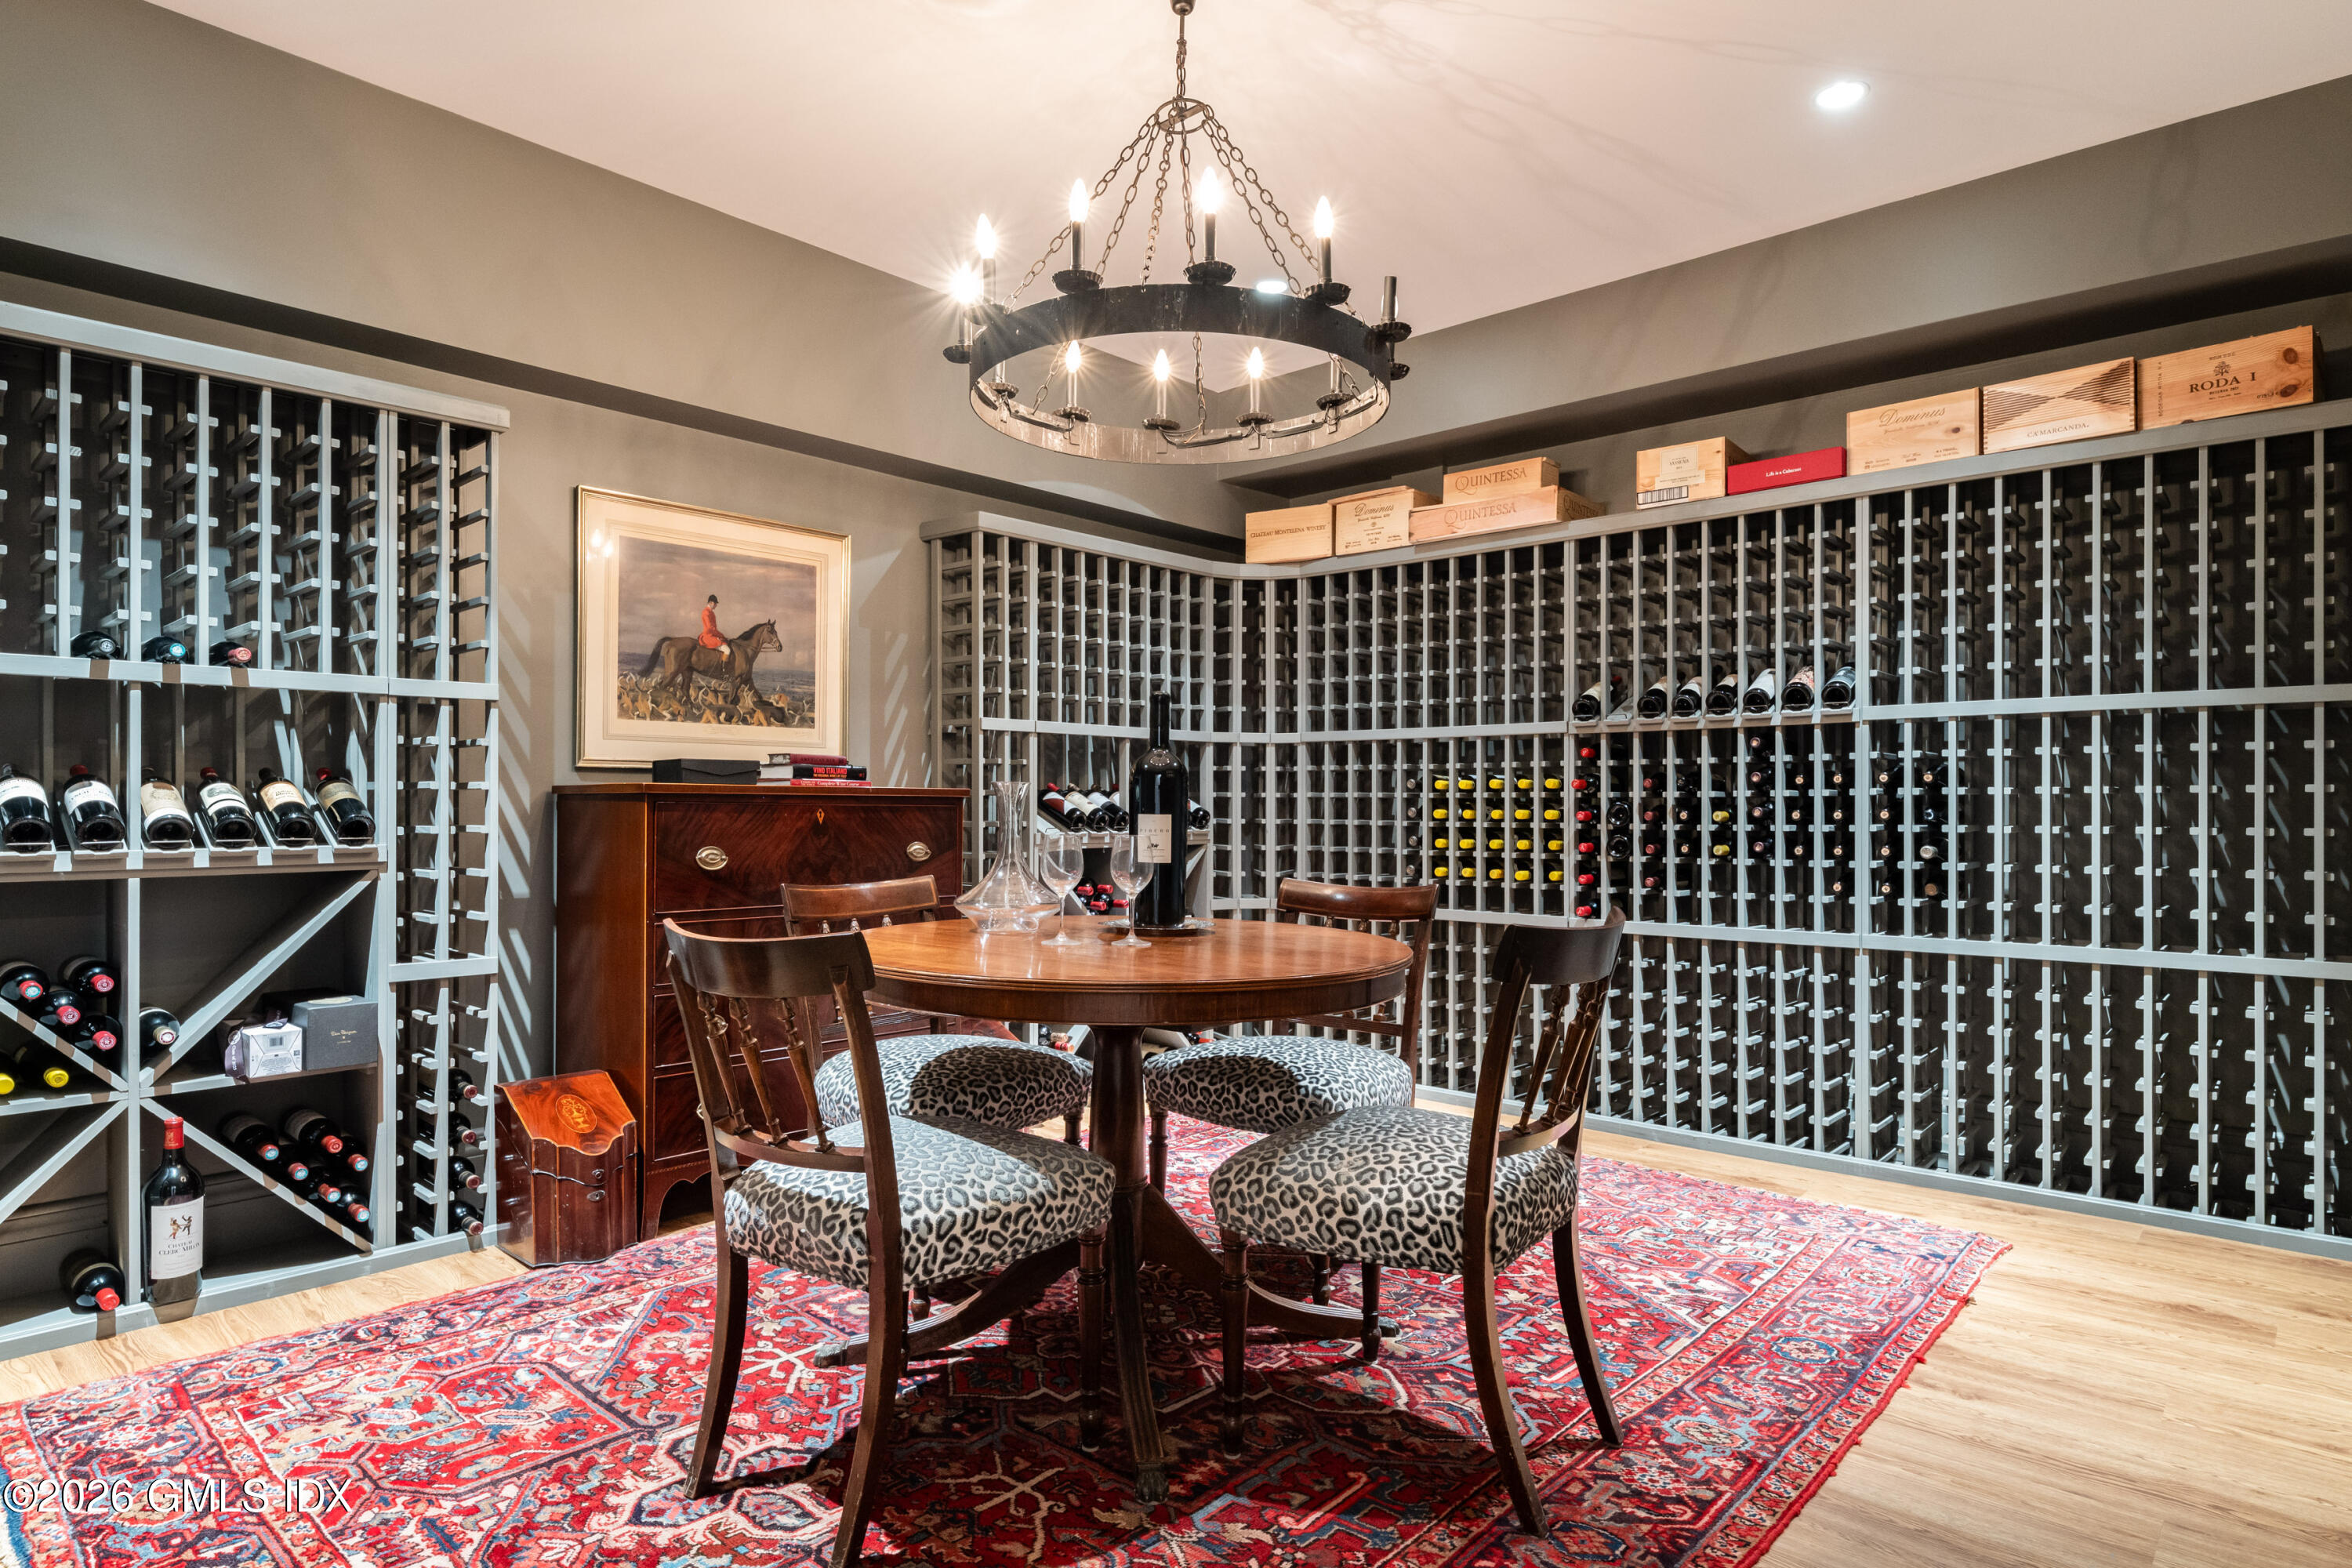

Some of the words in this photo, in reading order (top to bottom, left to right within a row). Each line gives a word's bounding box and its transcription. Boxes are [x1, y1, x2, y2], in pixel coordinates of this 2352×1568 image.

[2189, 376, 2241, 393] RODA
[2249, 372, 2256, 382] I
[1878, 407, 1946, 427] Dominus
[1455, 467, 1527, 495] QUINTESSA
[1355, 503, 1395, 517] Dominus
[1444, 502, 1517, 529] QUINTESSA
[1274, 528, 1305, 536] MONTELENA
